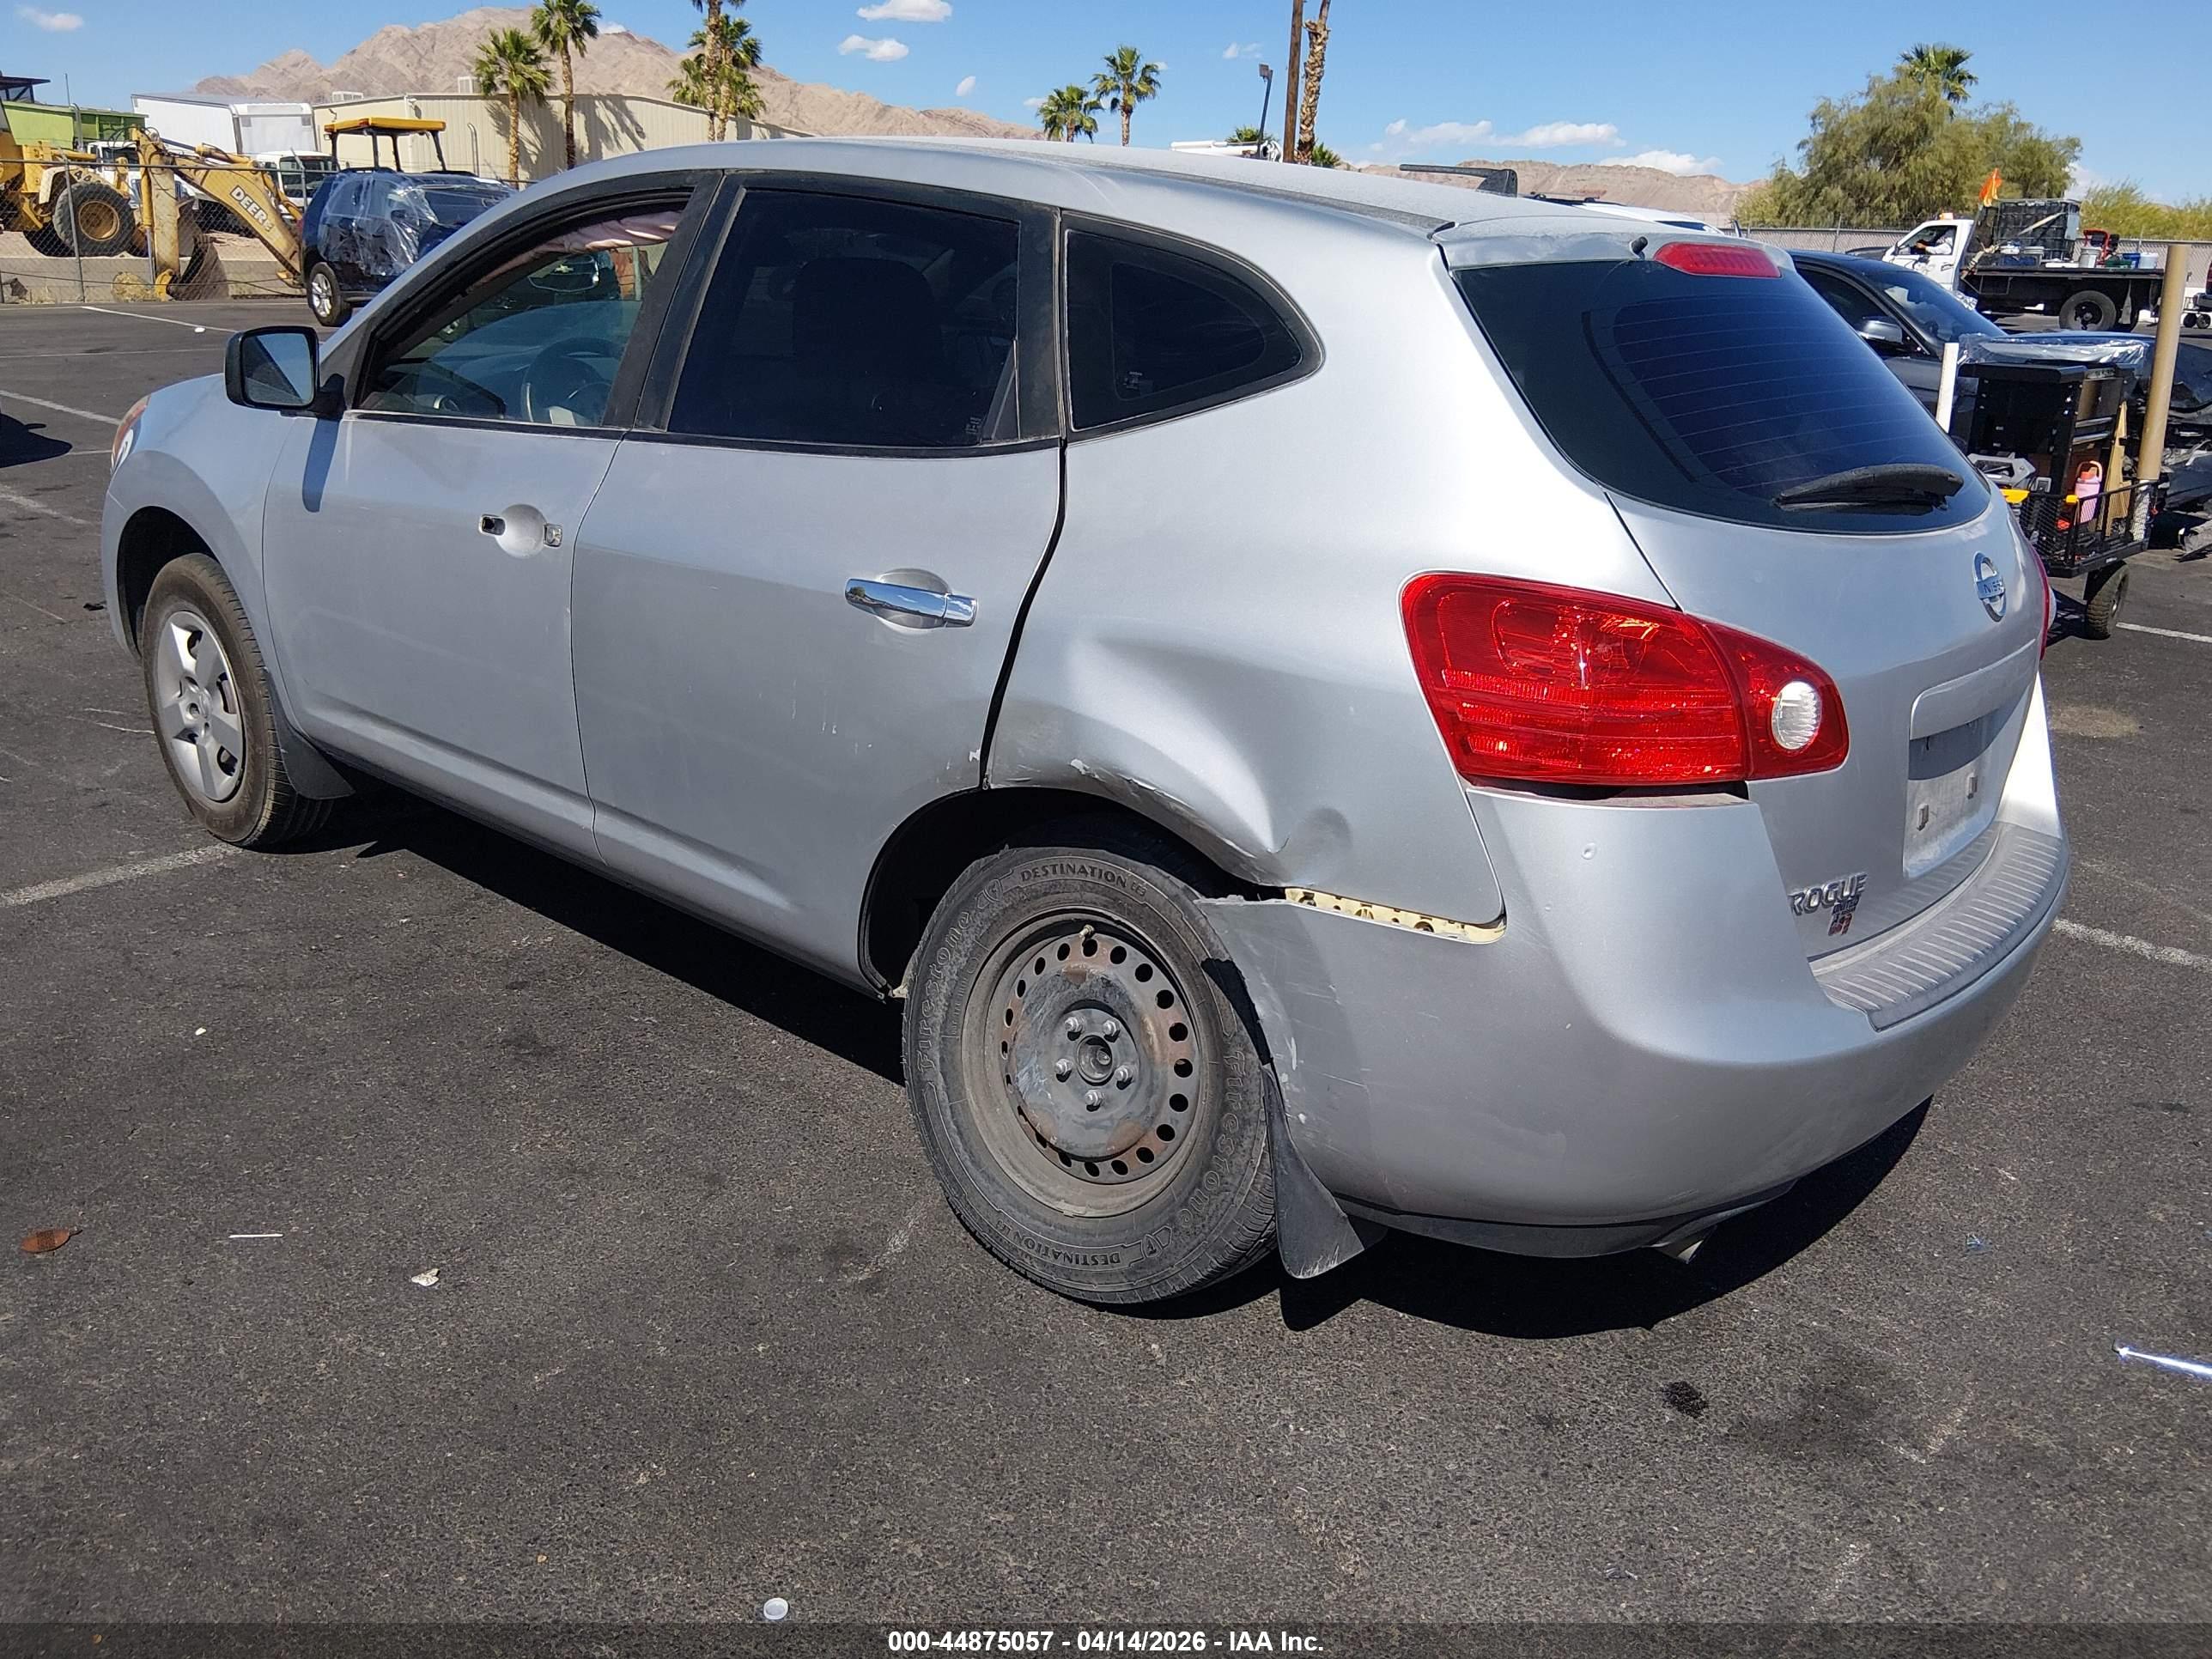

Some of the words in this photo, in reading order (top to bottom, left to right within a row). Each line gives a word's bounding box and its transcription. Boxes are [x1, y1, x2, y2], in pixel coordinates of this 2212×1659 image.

[229, 185, 275, 233] DEERE
[1020, 863, 1127, 888] DESTINATION
[1788, 872, 1867, 916] ROGUE
[1013, 1229, 1121, 1267] DESTINATION
